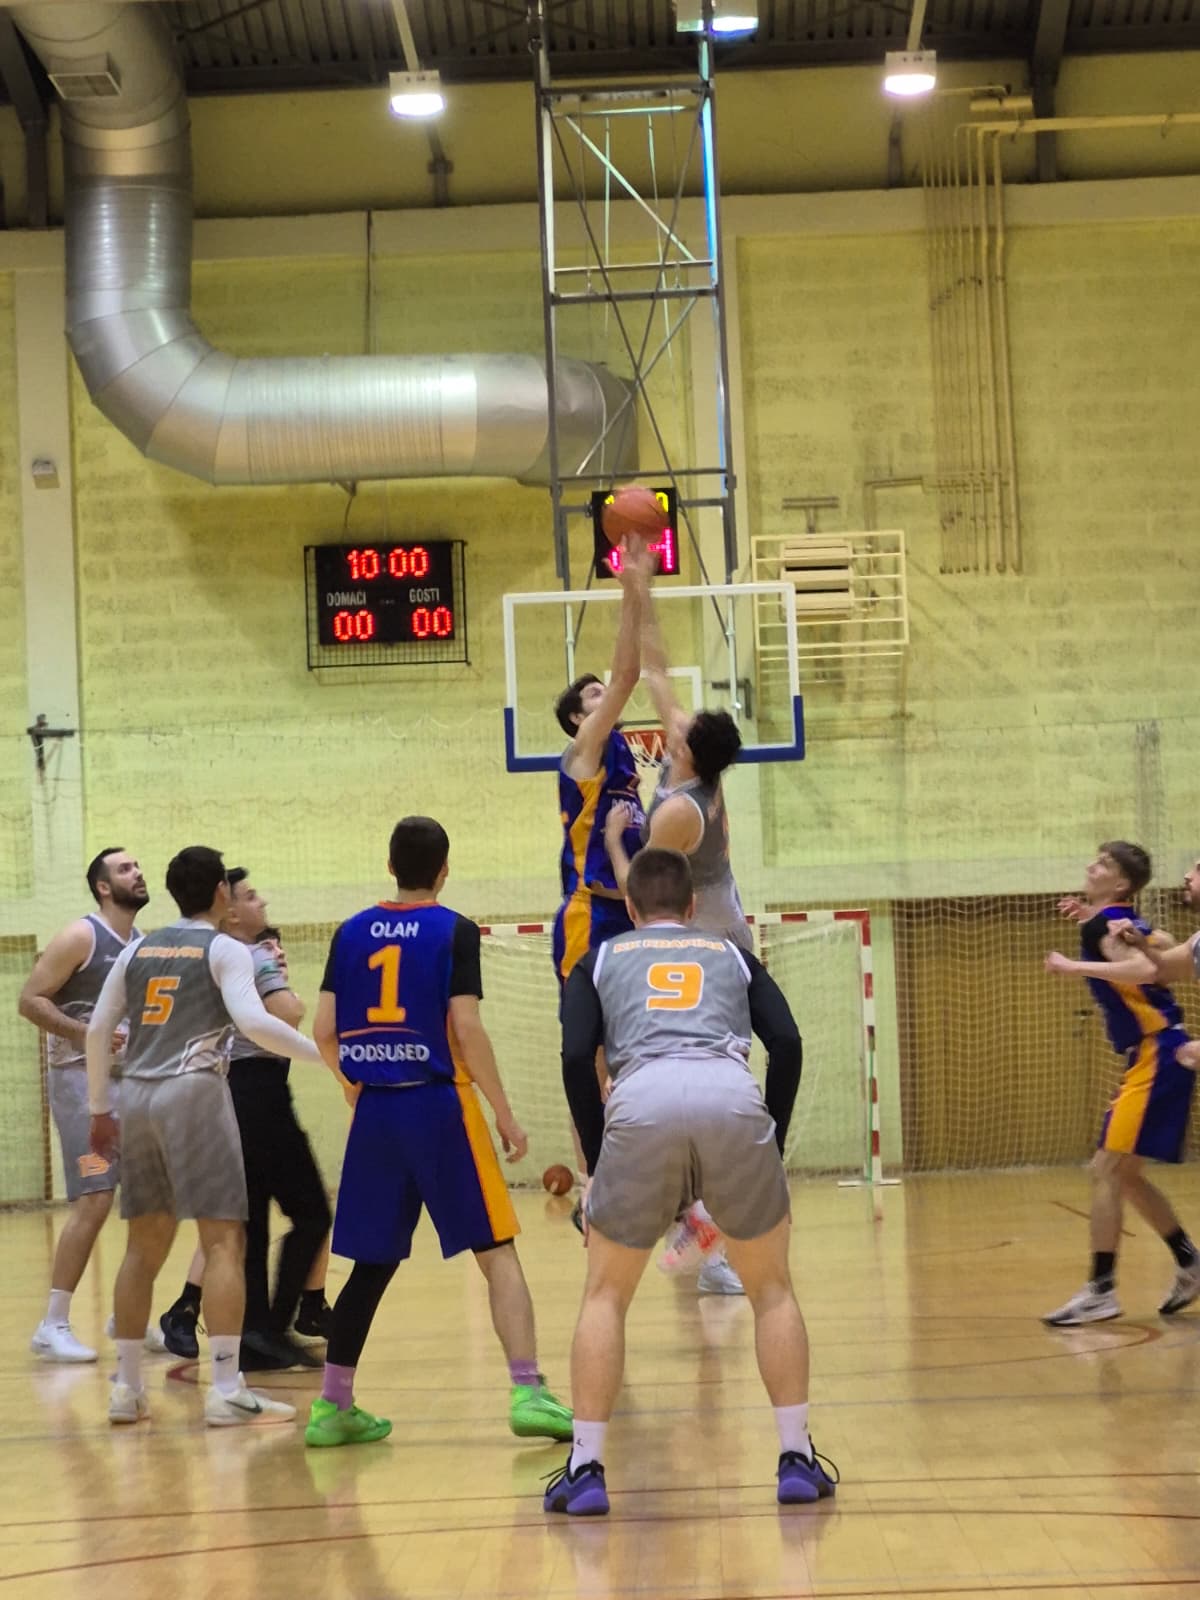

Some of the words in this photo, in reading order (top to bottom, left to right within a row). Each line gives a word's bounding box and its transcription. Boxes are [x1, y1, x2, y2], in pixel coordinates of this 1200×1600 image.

[347, 547, 429, 579] 10:00
[409, 588, 440, 603] GOSTI
[334, 610, 374, 640] 00
[412, 607, 452, 636] 00
[370, 921, 419, 938] OLAH
[366, 944, 406, 1023] 1
[647, 962, 704, 1011] 9
[141, 975, 181, 1025] 5
[340, 1043, 430, 1062] PODSUSED
